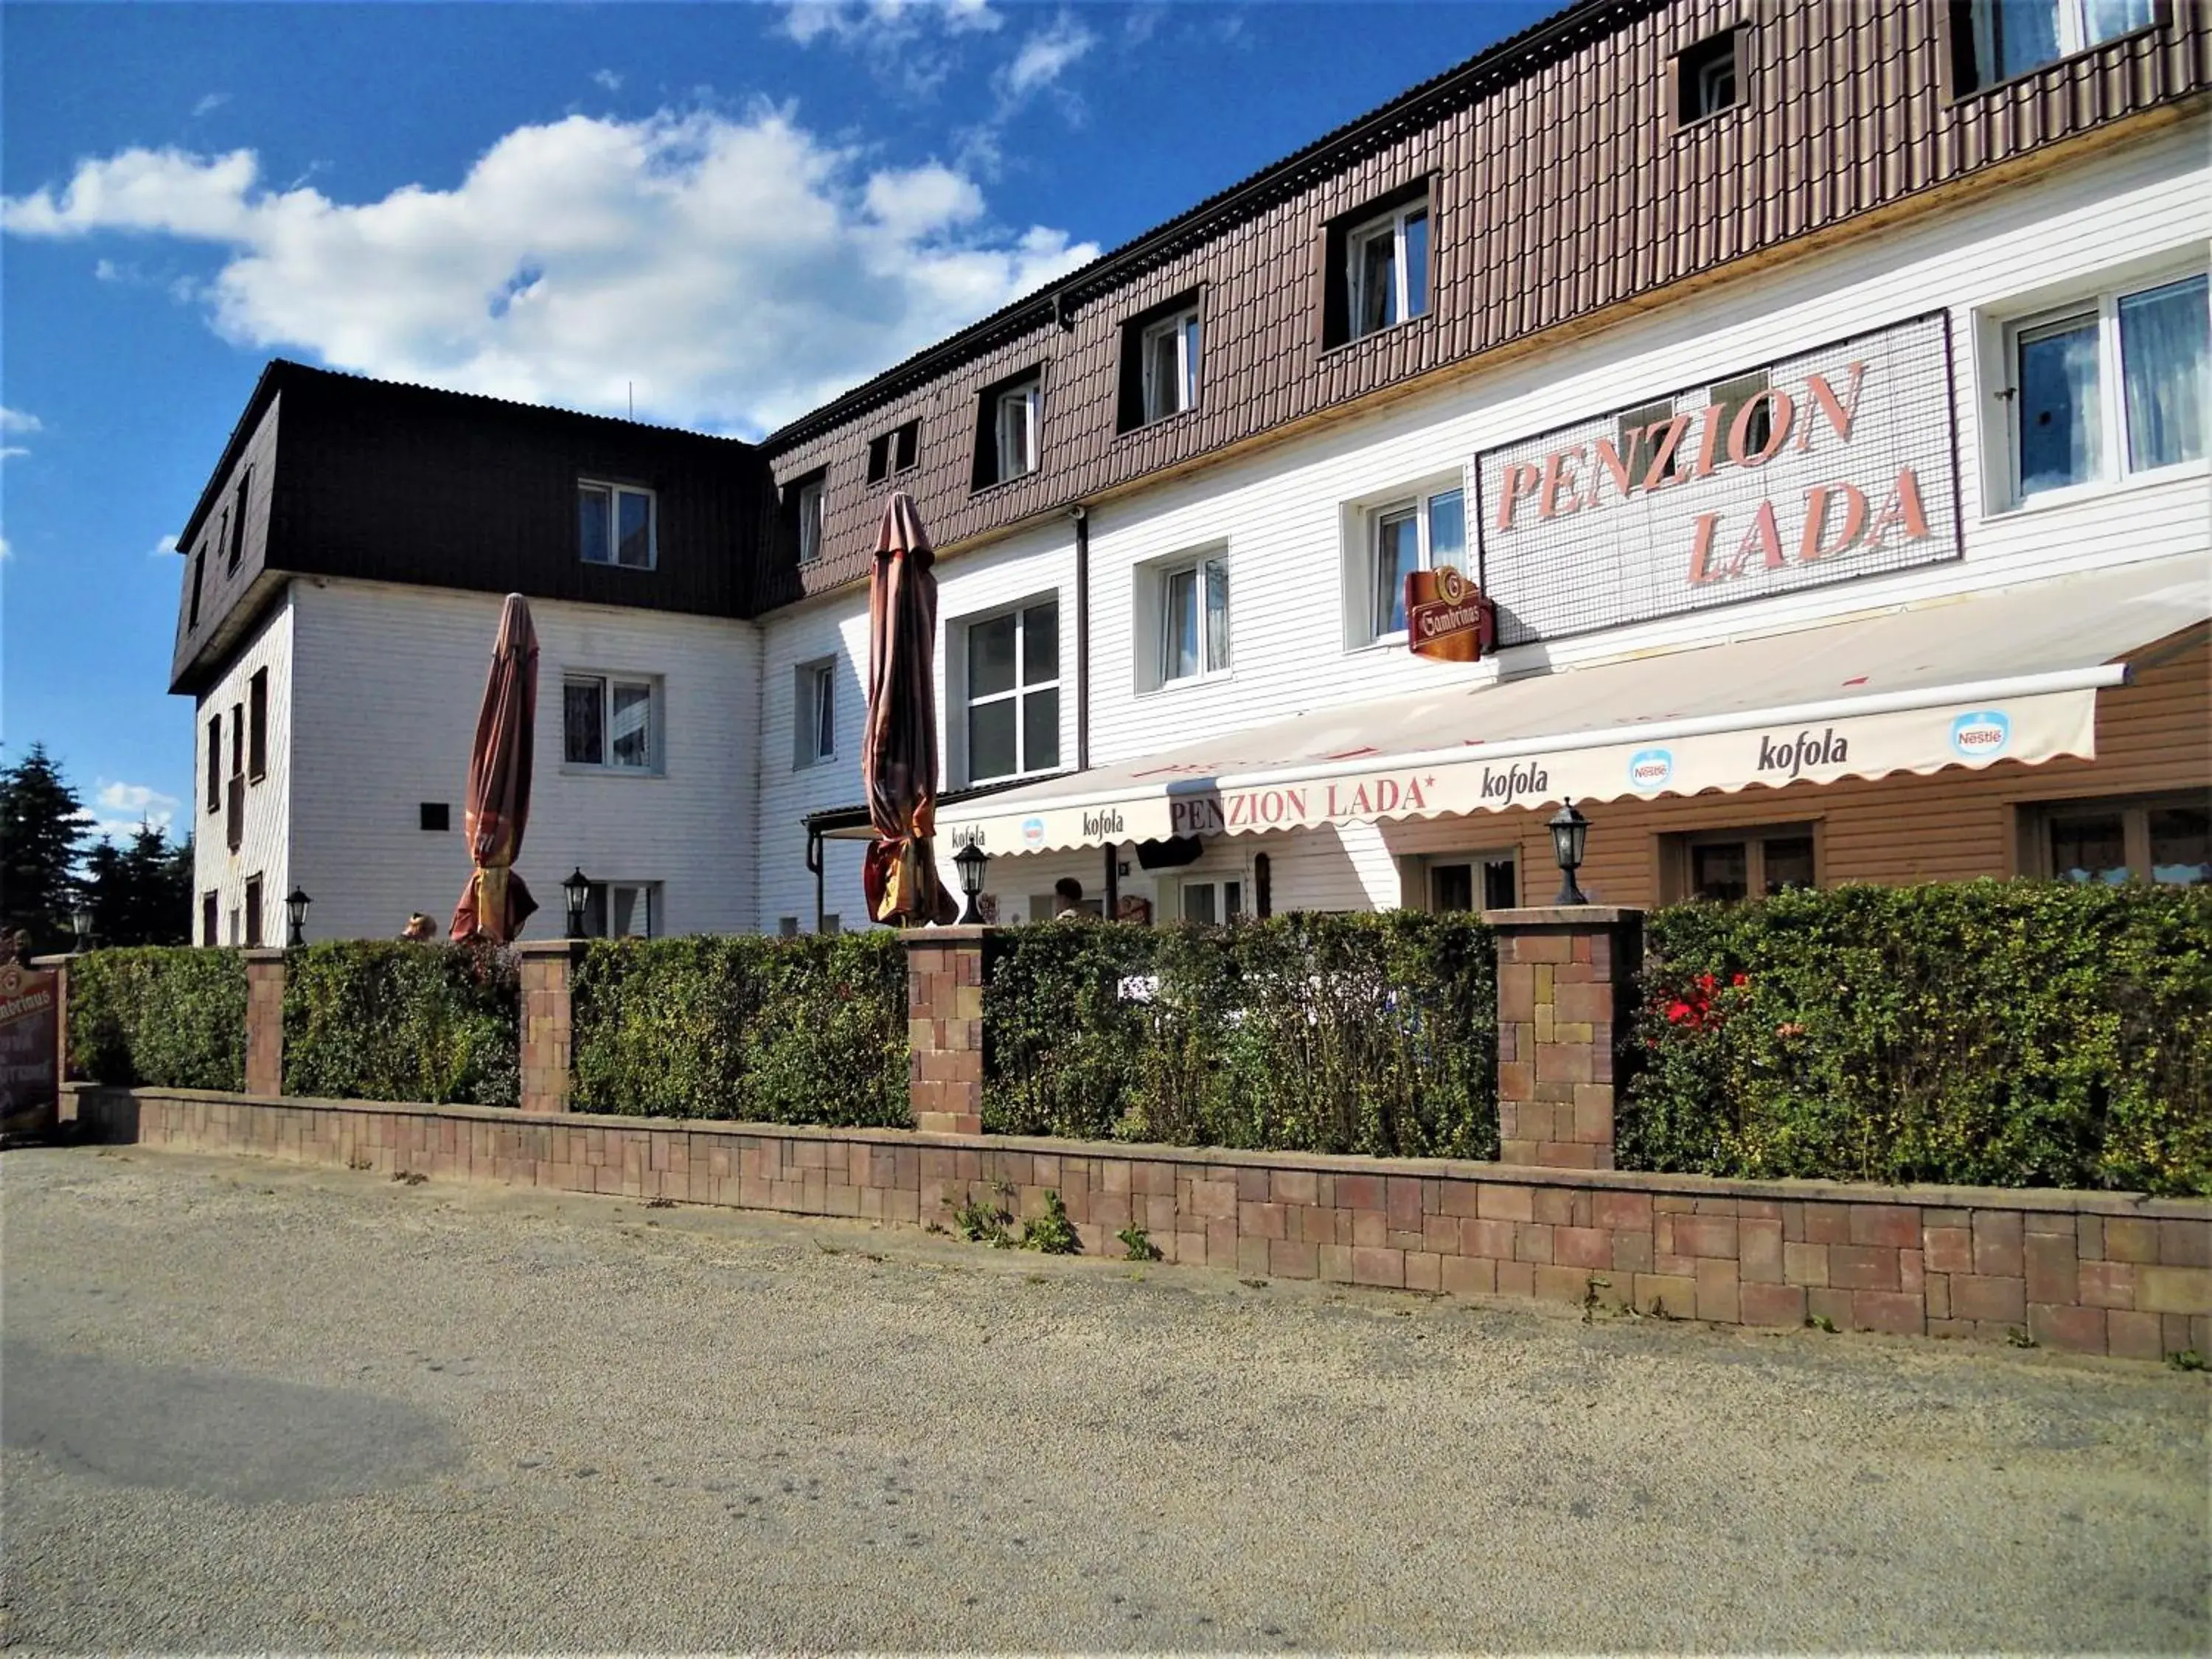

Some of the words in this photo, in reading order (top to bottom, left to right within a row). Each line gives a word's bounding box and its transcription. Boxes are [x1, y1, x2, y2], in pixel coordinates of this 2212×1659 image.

[1496, 360, 1870, 532] PENZION
[1687, 465, 1928, 585] LADA
[1422, 605, 1480, 636] Gambrinus
[1758, 728, 1848, 778] kofola
[1481, 762, 1548, 805] kofola
[1083, 808, 1124, 842] kofola
[1172, 788, 1308, 832] PENZION
